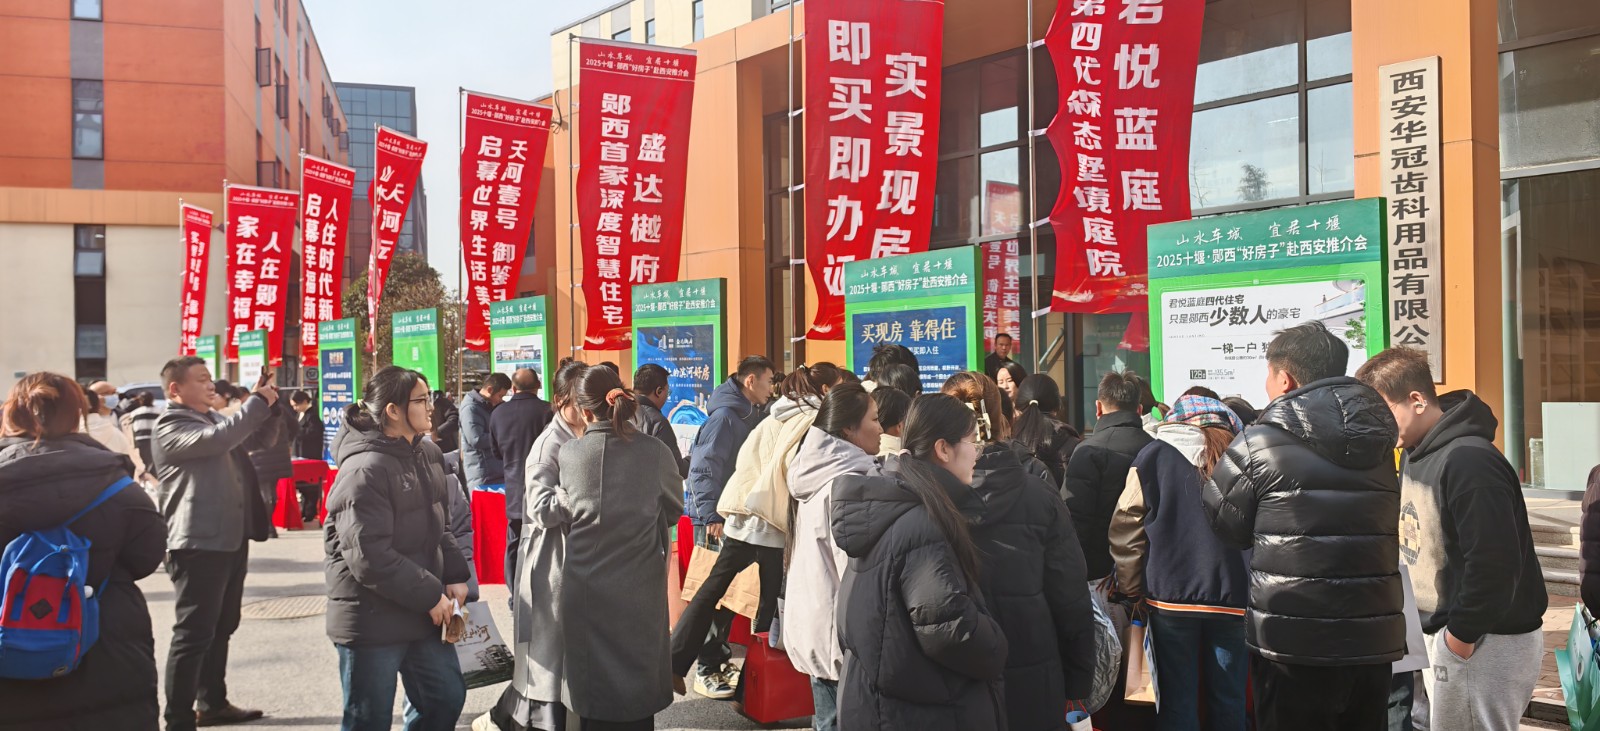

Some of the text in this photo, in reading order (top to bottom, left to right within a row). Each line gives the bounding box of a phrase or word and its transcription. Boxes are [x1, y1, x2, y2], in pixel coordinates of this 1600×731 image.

[495, 139, 528, 231] 天河壹号
[870, 52, 927, 261] 实景现房
[595, 91, 632, 326] 郧西首家深度智慧住宅
[628, 132, 667, 284] 盛达樾府
[1176, 215, 1342, 246] 山水车城 宜居十堰
[1389, 67, 1430, 347] 西安华冠齿科用品有限公
[253, 231, 281, 333] 人在郧西
[302, 193, 323, 347] 启幕幸福新程
[860, 258, 953, 279] 山水车城 宜居十堰
[1169, 294, 1245, 309] 君悦蓝庭四代住宅
[861, 318, 957, 344] 买现房 靠得住
[1169, 305, 1301, 327] 只是郧西少数人的豪宅
[1211, 342, 1258, 354] 一梯一户
